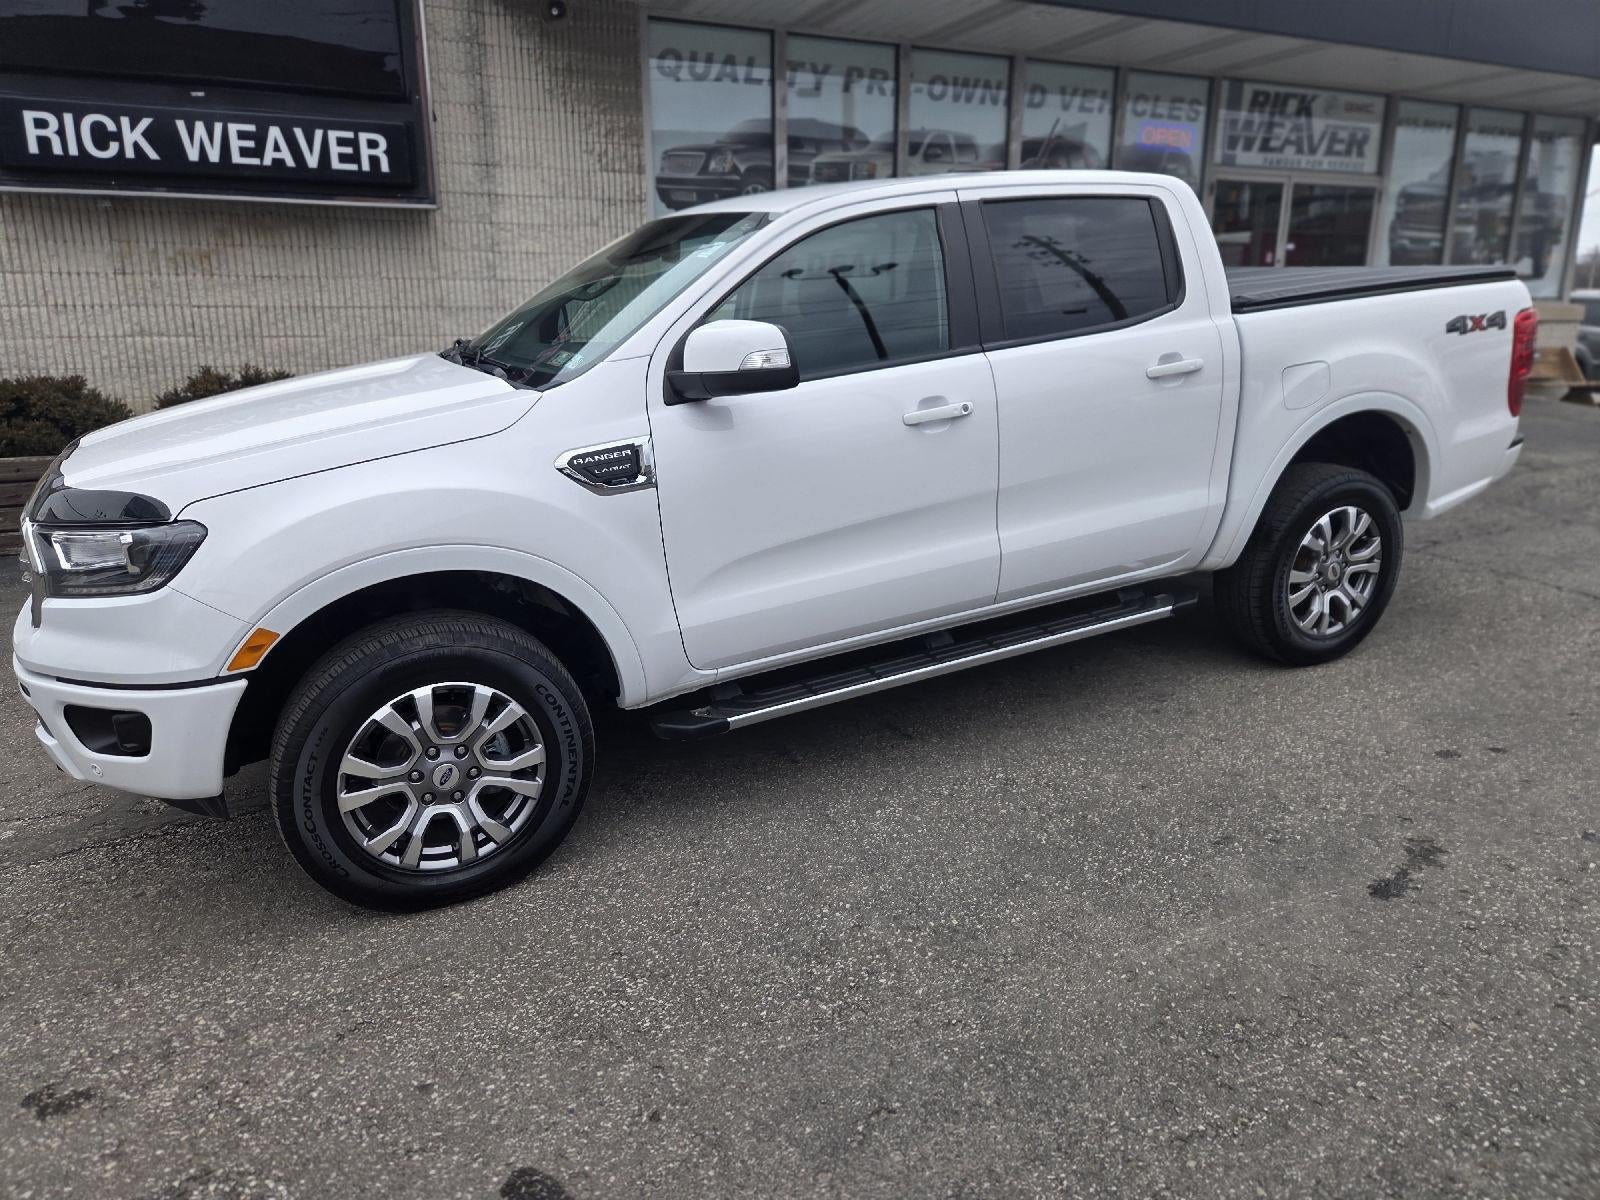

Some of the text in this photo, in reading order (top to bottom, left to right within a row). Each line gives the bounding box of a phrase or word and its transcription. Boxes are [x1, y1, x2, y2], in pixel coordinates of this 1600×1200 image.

[656, 47, 1204, 122] QUALTY PR-OWND VECLES
[1249, 89, 1318, 117] RICK
[22, 109, 391, 173] RICK WEAVER
[1142, 127, 1193, 148] OPEN
[1225, 117, 1371, 158] WEAVER
[573, 449, 632, 465] RANGER
[535, 683, 579, 809] CONTINENTAL
